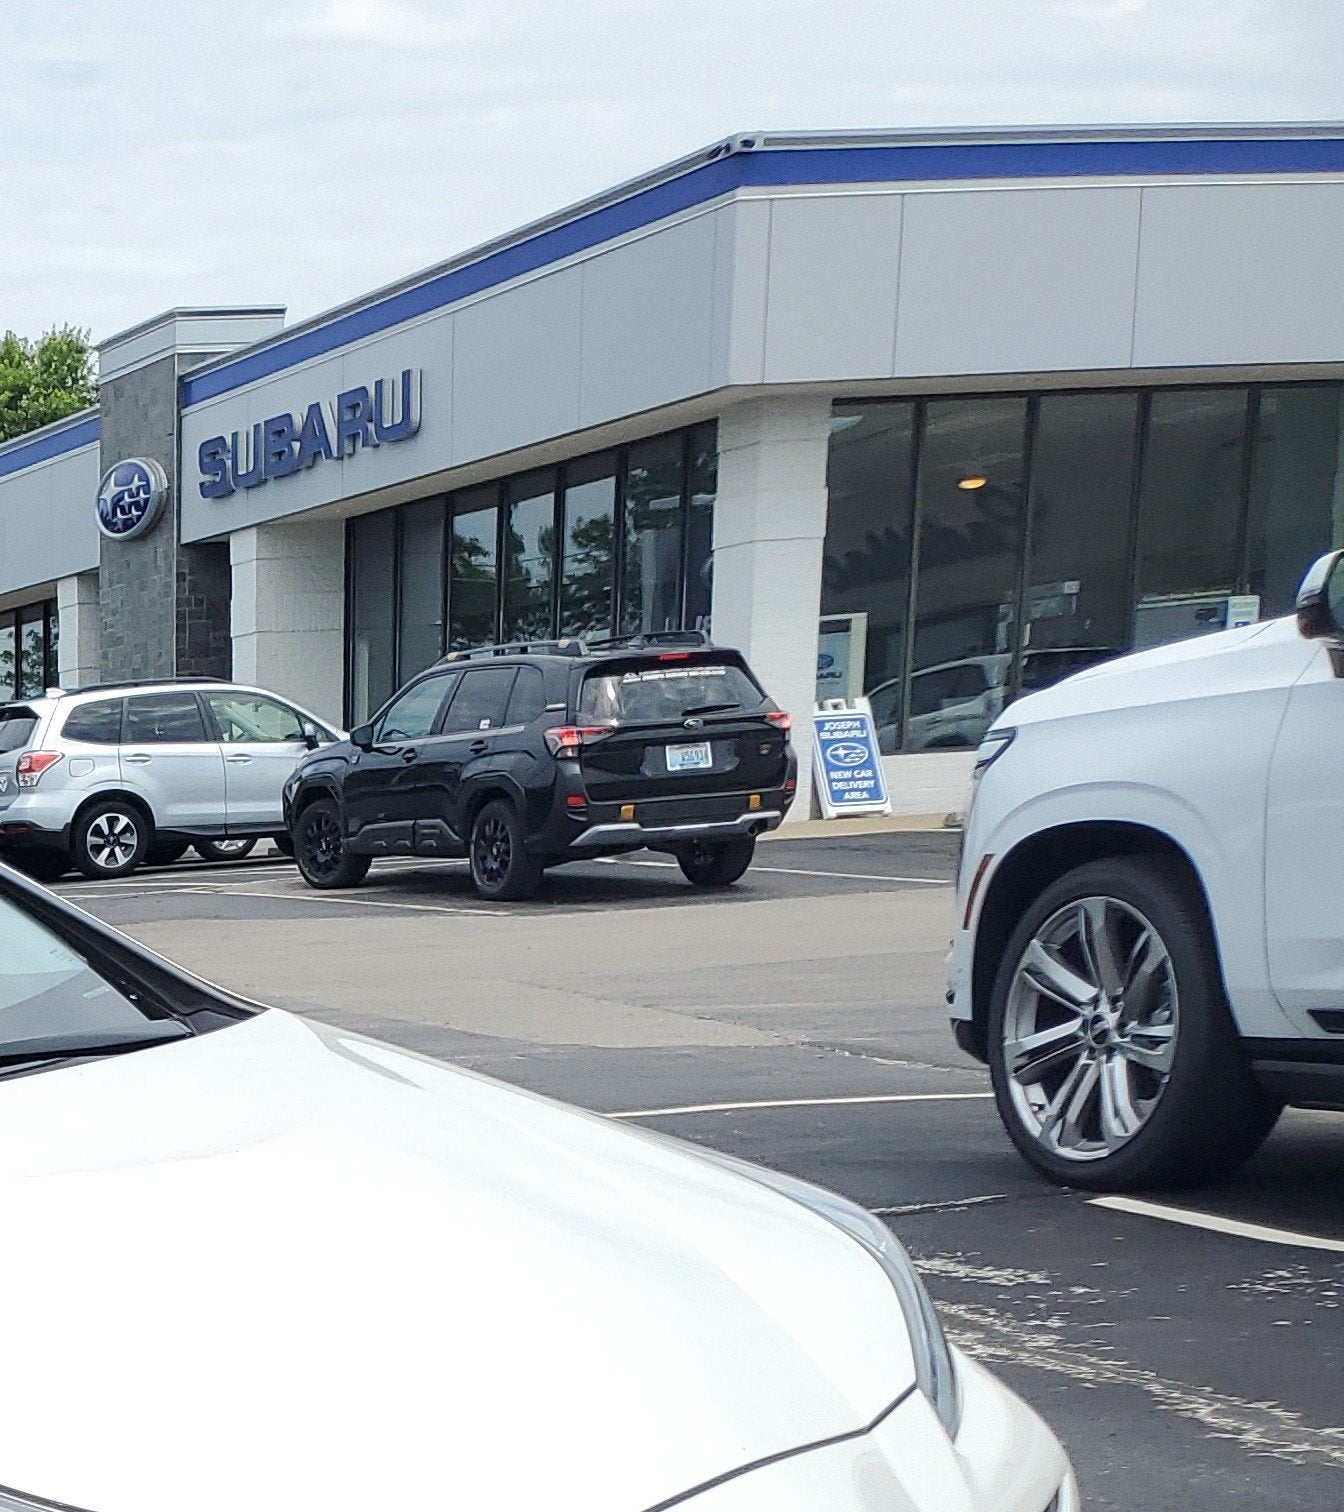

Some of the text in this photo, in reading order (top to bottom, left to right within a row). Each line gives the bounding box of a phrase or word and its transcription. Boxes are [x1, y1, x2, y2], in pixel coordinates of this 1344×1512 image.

[198, 368, 422, 499] SUBARU
[824, 721, 861, 731] JOSEPH
[819, 730, 867, 739] SUBARU
[830, 769, 873, 779] NEW CAR
[832, 780, 875, 790] DELIVERY
[844, 791, 869, 799] AREA
